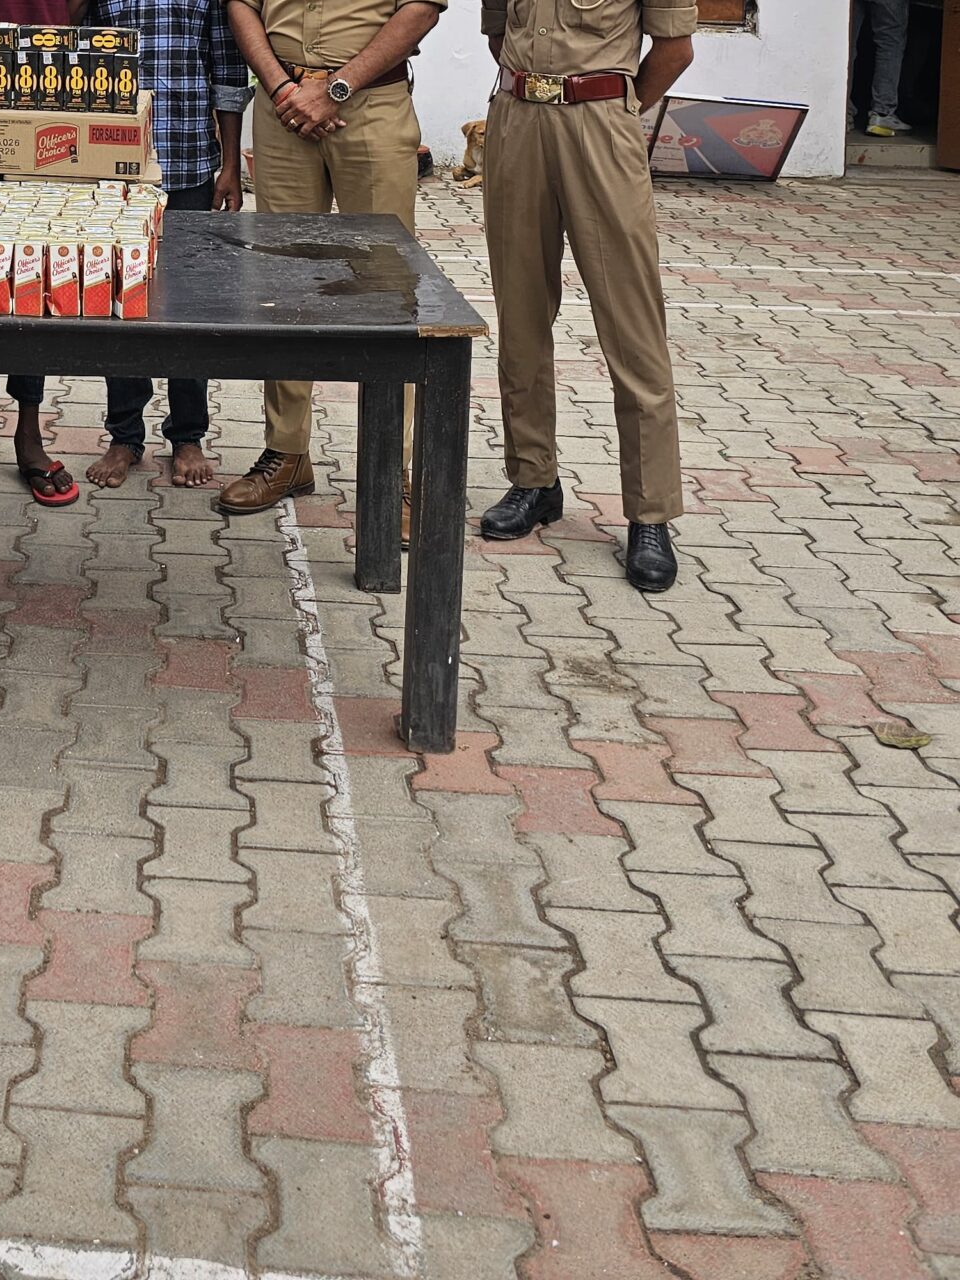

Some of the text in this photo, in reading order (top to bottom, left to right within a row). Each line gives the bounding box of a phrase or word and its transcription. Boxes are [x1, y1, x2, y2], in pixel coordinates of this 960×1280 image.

[38, 130, 76, 149] Officer's
[92, 128, 139, 142] FOR SALE IN U.P.
[36, 145, 67, 160] Choice
[16, 266, 34, 275] Choice
[52, 267, 70, 276] Choice
[85, 267, 104, 276] Choice
[125, 271, 141, 280] Choice
